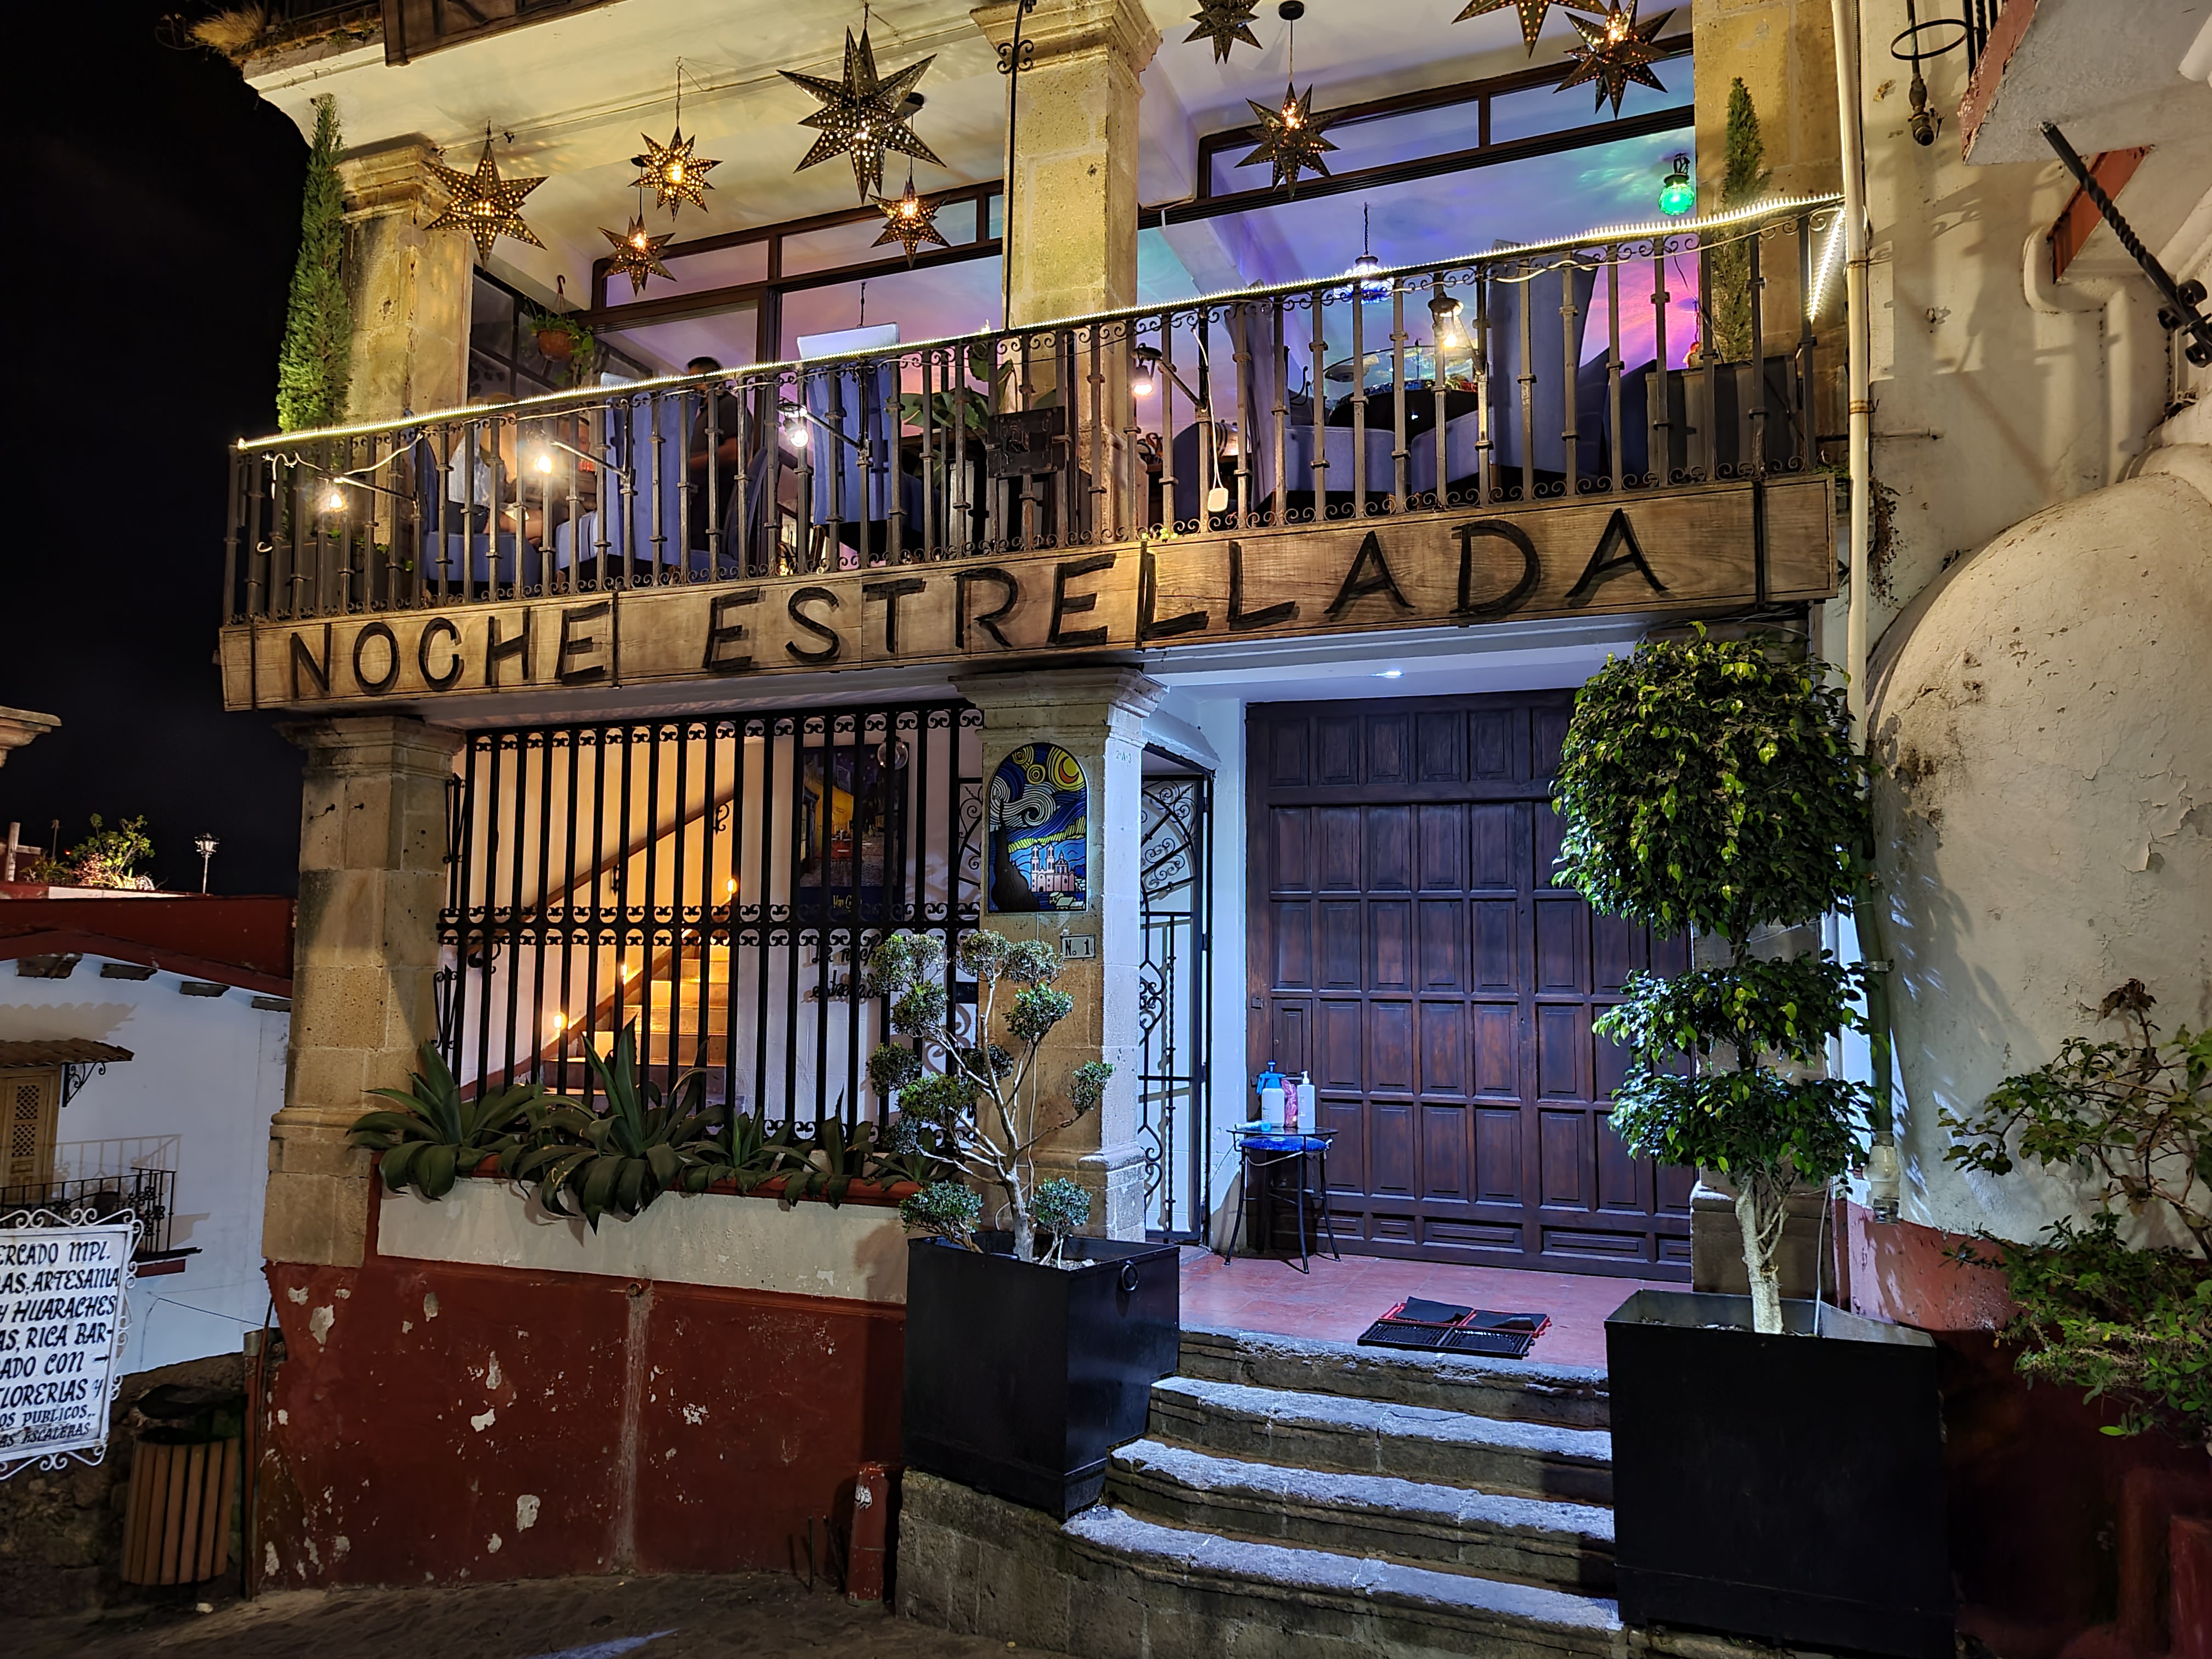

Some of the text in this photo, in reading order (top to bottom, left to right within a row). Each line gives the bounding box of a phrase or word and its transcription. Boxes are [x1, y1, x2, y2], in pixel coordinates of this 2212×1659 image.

[290, 507, 1669, 699] NOCHE ESTRELLADA
[1084, 939, 1091, 955] 1
[0, 1268, 120, 1296] AS, ARTESANIA
[11, 1295, 117, 1323] HUARACHES
[25, 1325, 67, 1350] RICA
[74, 1322, 112, 1345] BAR-
[0, 1351, 84, 1380] ADO CON
[0, 1378, 88, 1409] LORERIAS
